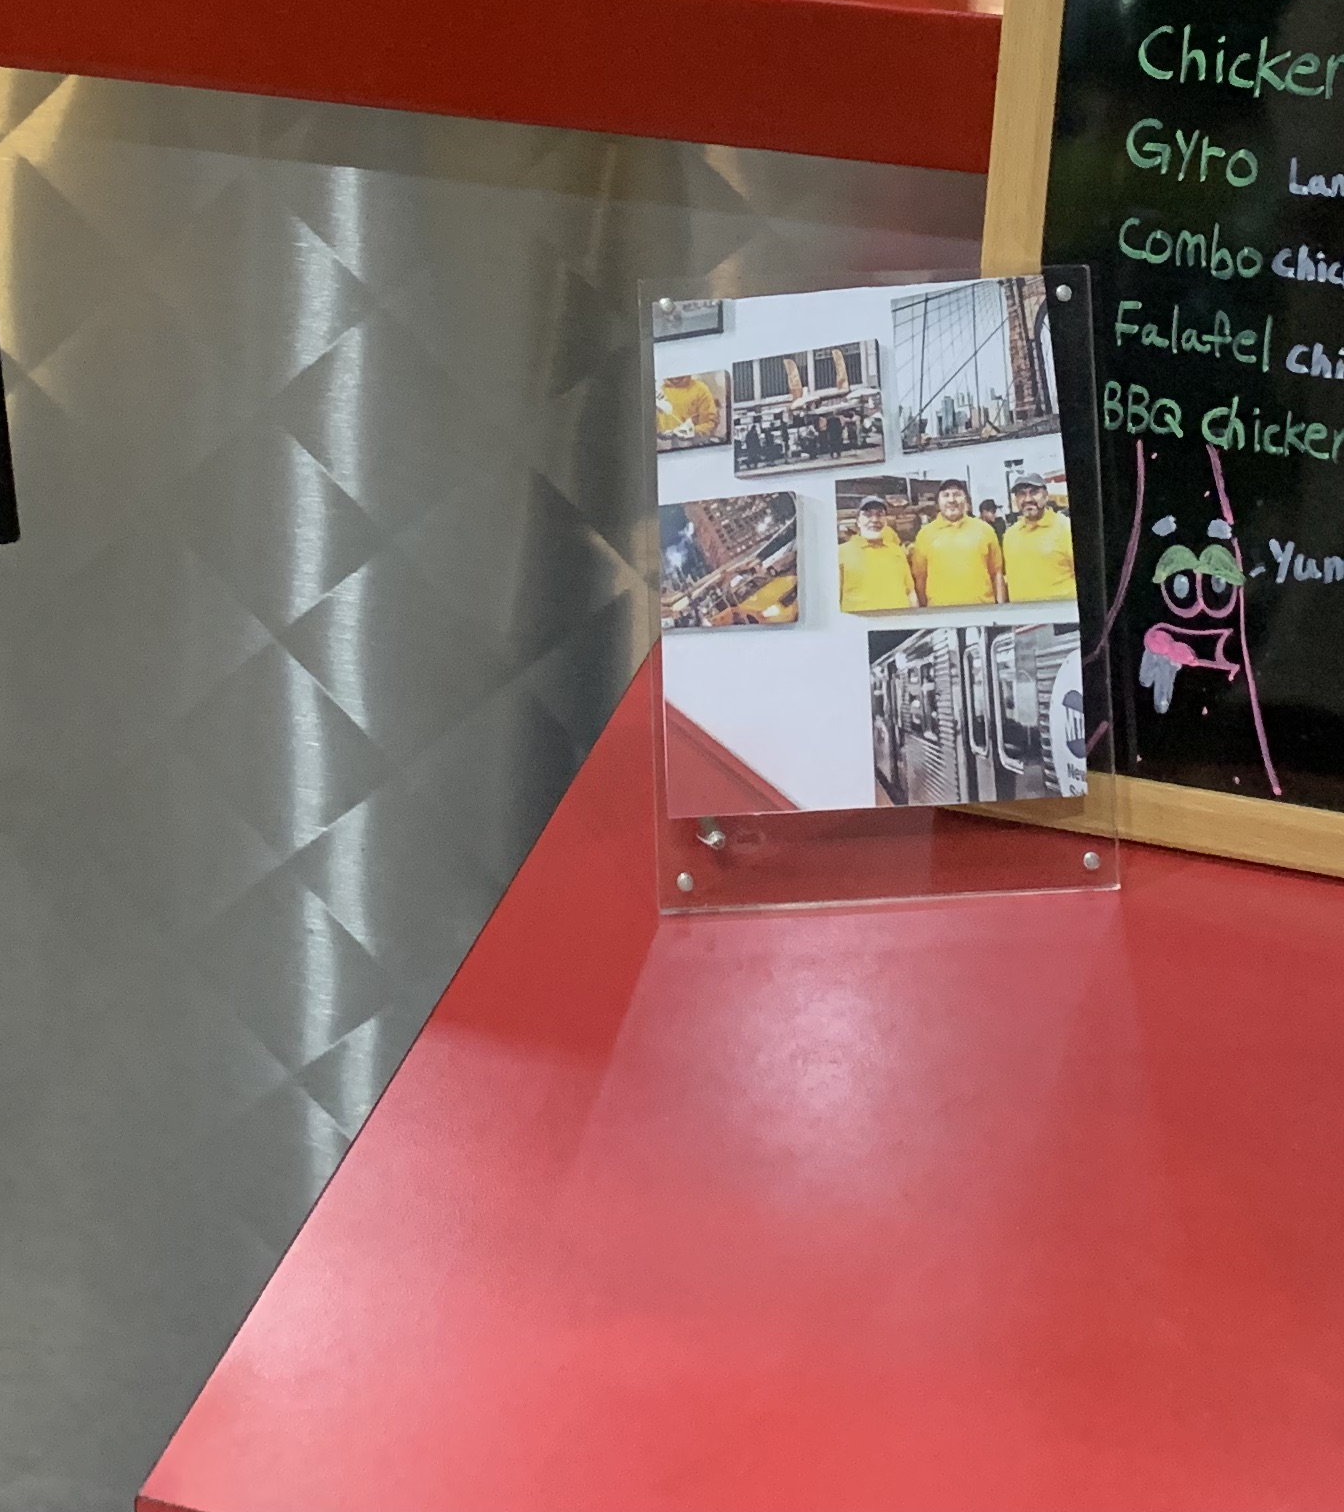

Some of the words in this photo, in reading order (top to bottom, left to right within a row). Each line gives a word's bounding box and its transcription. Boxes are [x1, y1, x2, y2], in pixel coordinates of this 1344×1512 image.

[1125, 117, 1258, 188] Gyro
[1118, 217, 1264, 280] Combo
[1114, 299, 1274, 373] Falafel
[1103, 380, 1184, 439] BBQ
